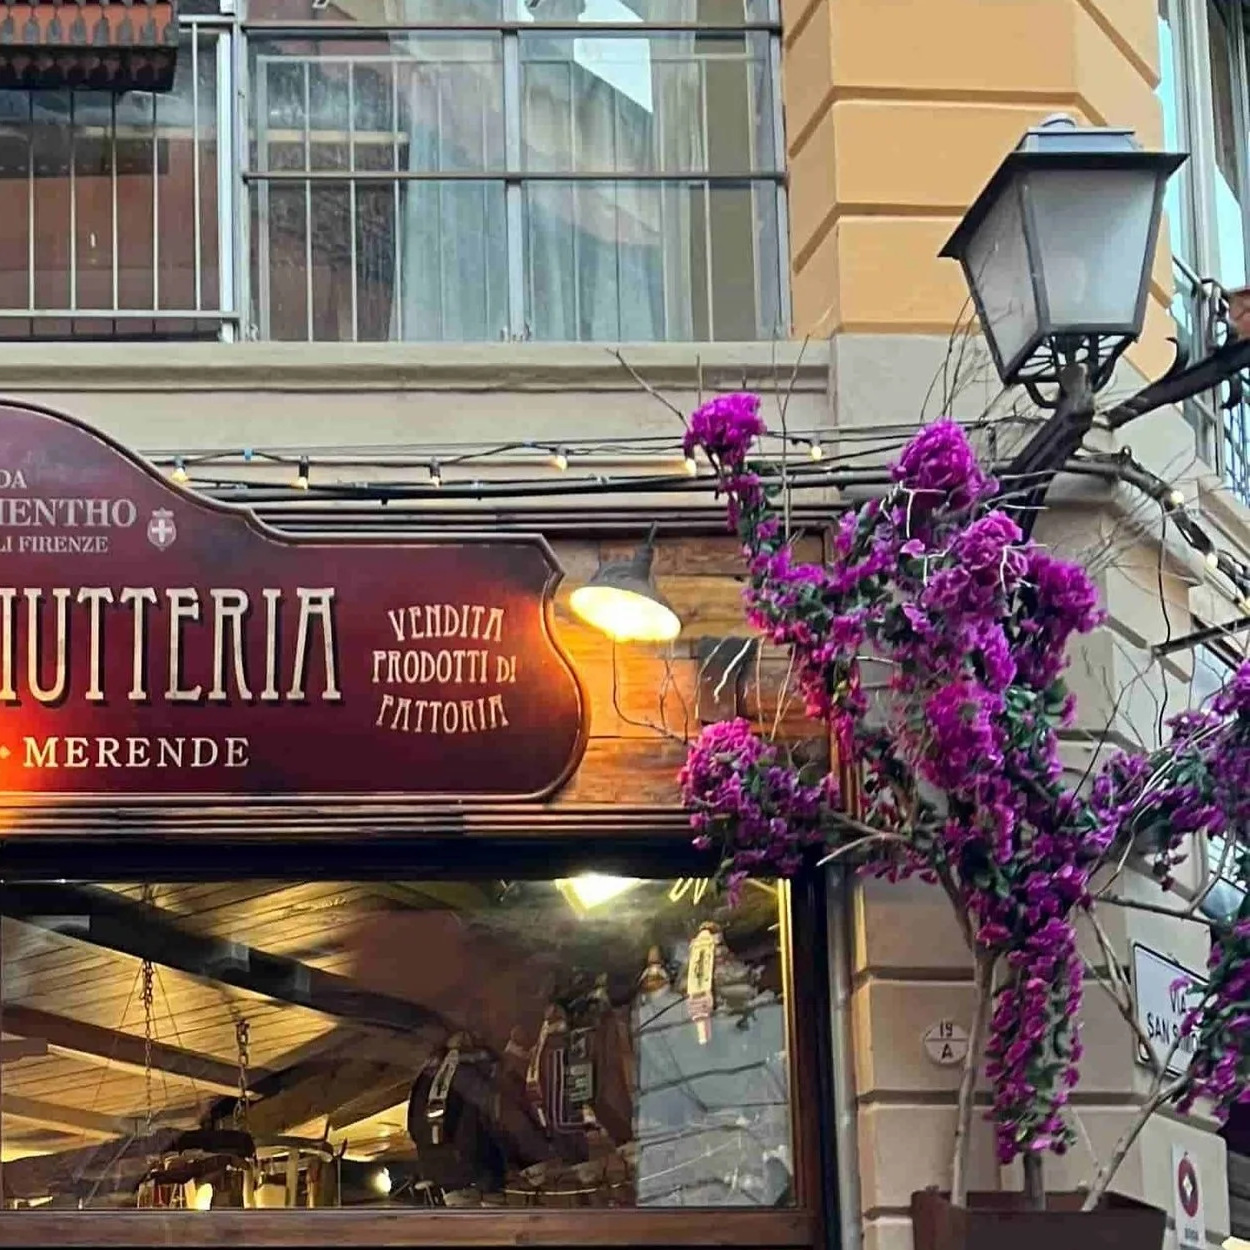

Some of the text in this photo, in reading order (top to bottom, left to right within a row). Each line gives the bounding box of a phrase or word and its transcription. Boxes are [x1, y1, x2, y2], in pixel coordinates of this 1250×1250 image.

[19, 536, 109, 553] FIRENZE
[387, 604, 506, 643] VENDITA
[372, 650, 517, 684] PRODOTTI DI
[375, 693, 510, 735] FATTORIA
[23, 735, 250, 768] MERENDE
[941, 1043, 954, 1059] A
